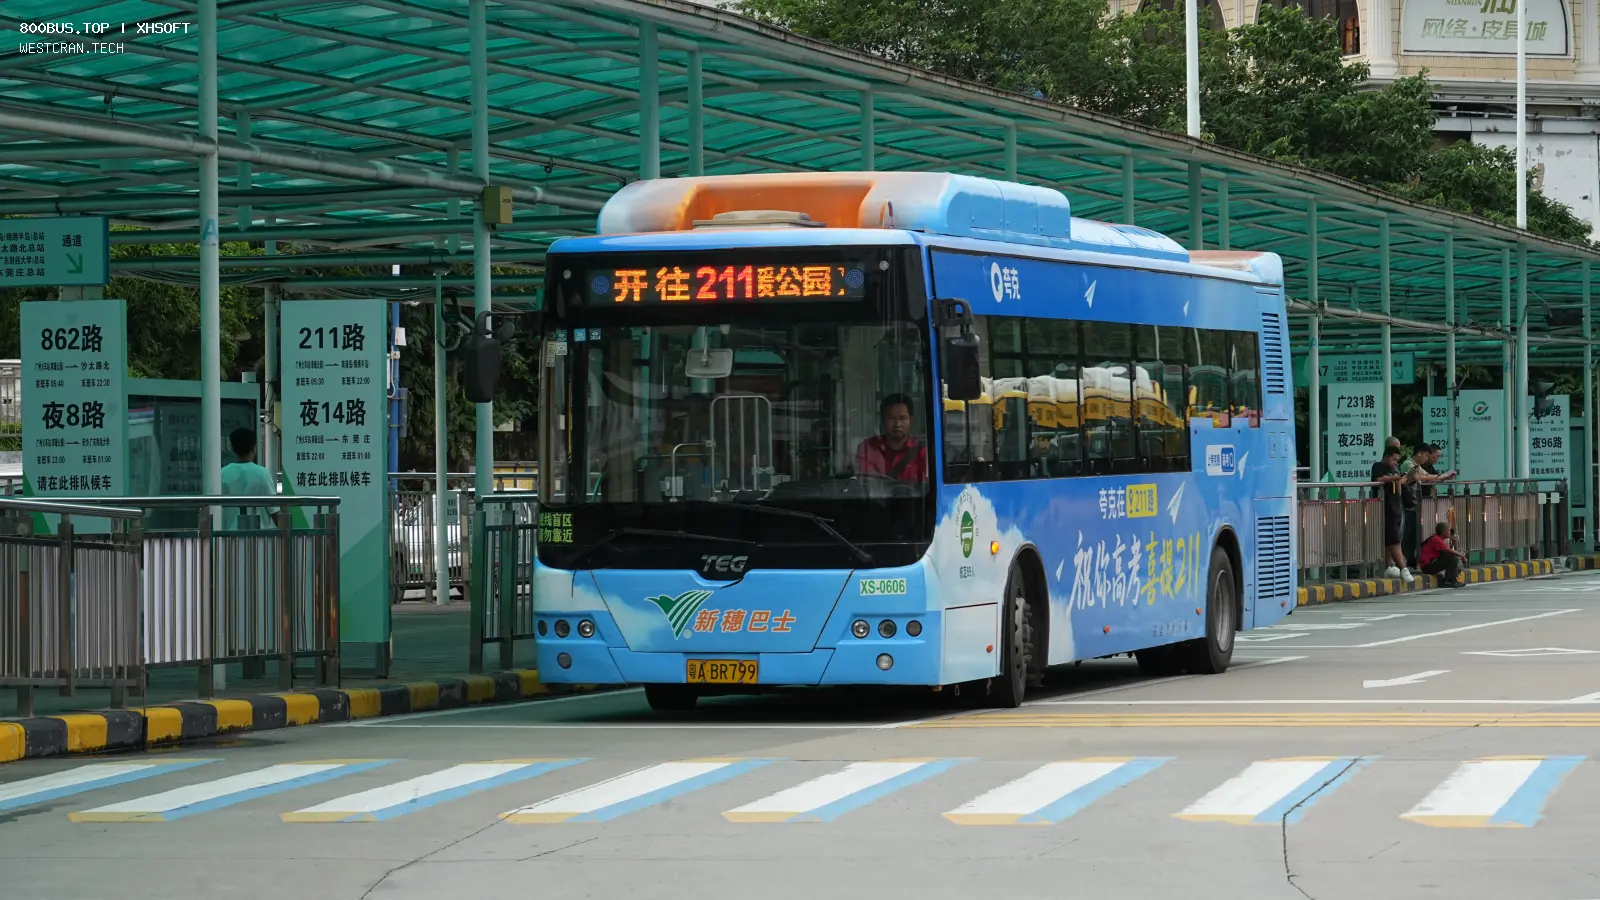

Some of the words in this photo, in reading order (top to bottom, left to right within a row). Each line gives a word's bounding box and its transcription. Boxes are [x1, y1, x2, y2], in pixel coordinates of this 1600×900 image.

[62, 234, 82, 247] 通道
[613, 266, 691, 301] 开往
[696, 266, 753, 299] 211
[1002, 266, 1021, 300] 夸克
[41, 324, 103, 352] 862路
[299, 323, 365, 351] 211路
[81, 361, 110, 370] 沙太路北
[1337, 395, 1375, 409] 广231路
[42, 401, 105, 429] 夜8路
[300, 398, 366, 426] 夜14路
[342, 435, 370, 443] 东莞庄
[1338, 433, 1374, 447] 夜25路
[1532, 437, 1562, 449] 夜96路
[37, 475, 111, 491] 请在此排队候车
[297, 471, 371, 487] 请在此排队候车
[1099, 487, 1126, 519] 夸克在
[1135, 488, 1154, 512] 211路
[701, 554, 748, 572] TEG
[1066, 529, 1200, 616] 祝你高考喜提211
[860, 579, 905, 594] XS-0606
[693, 608, 796, 633] 新穗巴士
